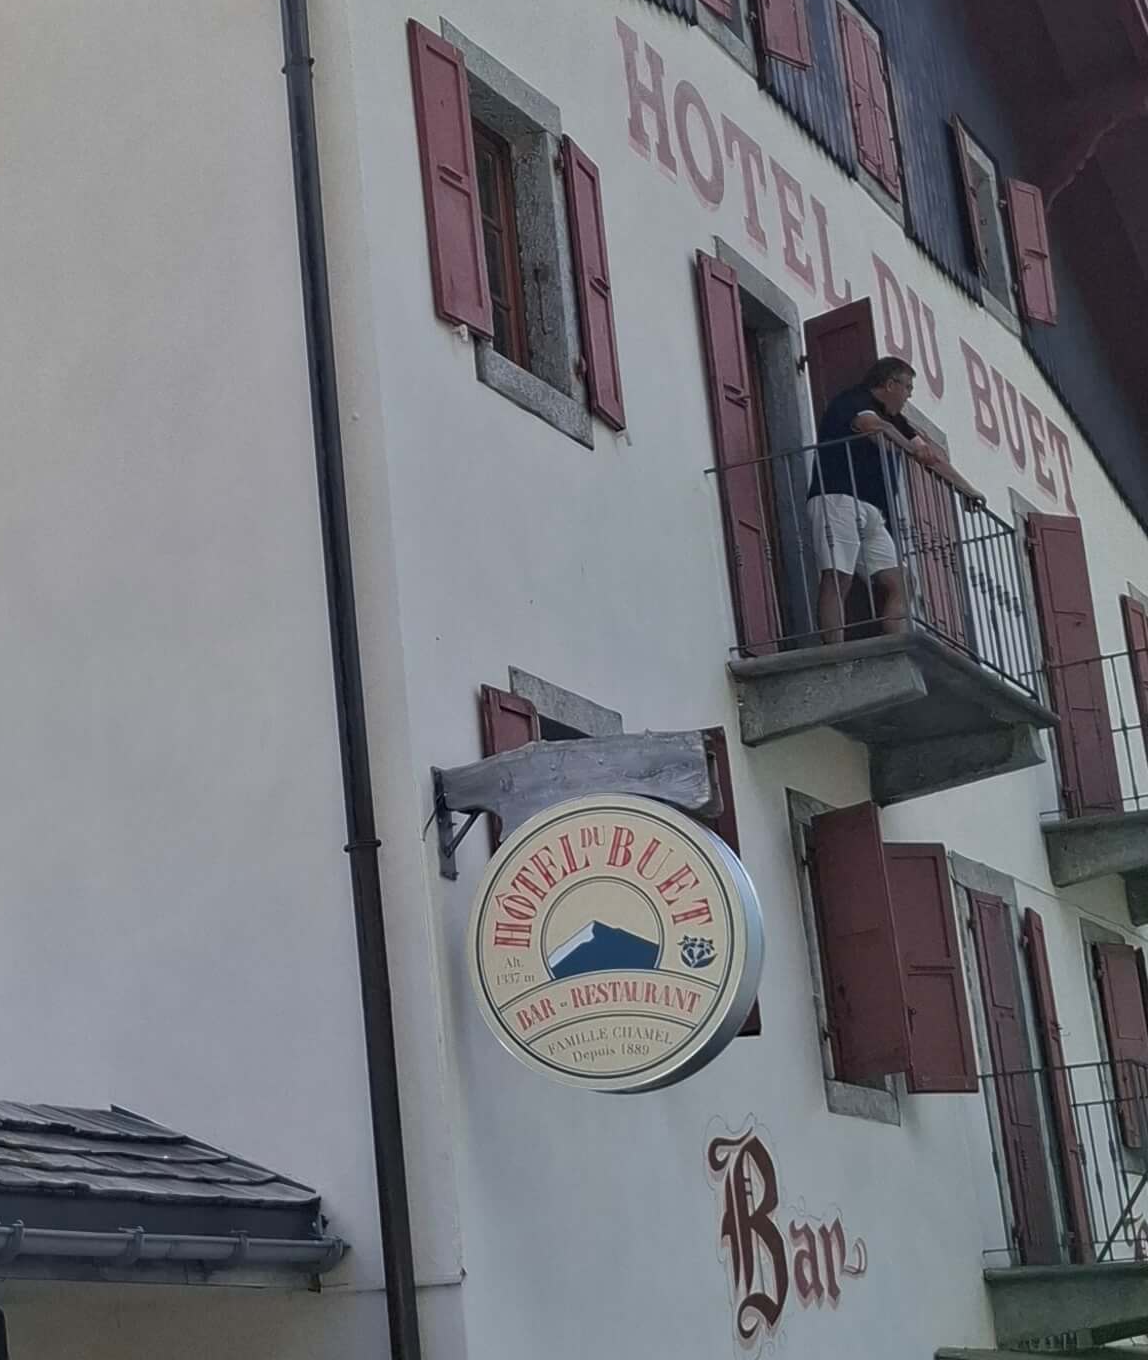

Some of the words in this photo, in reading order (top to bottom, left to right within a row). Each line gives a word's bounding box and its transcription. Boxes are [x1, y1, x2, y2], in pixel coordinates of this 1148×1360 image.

[615, 16, 851, 308] HOTEL
[871, 251, 944, 400] DU
[958, 336, 1077, 515] BUET
[493, 833, 590, 948] HÔTEL
[579, 825, 607, 848] DU
[606, 825, 714, 926] BUET
[516, 997, 557, 1031] BAR
[570, 980, 702, 1014] RESTAURANT
[548, 1027, 607, 1055] FAMILLE
[612, 1025, 674, 1046] CHAMEL
[572, 1044, 616, 1064] Depuis
[620, 1043, 650, 1057] 1889
[705, 1128, 868, 1346] Bar
